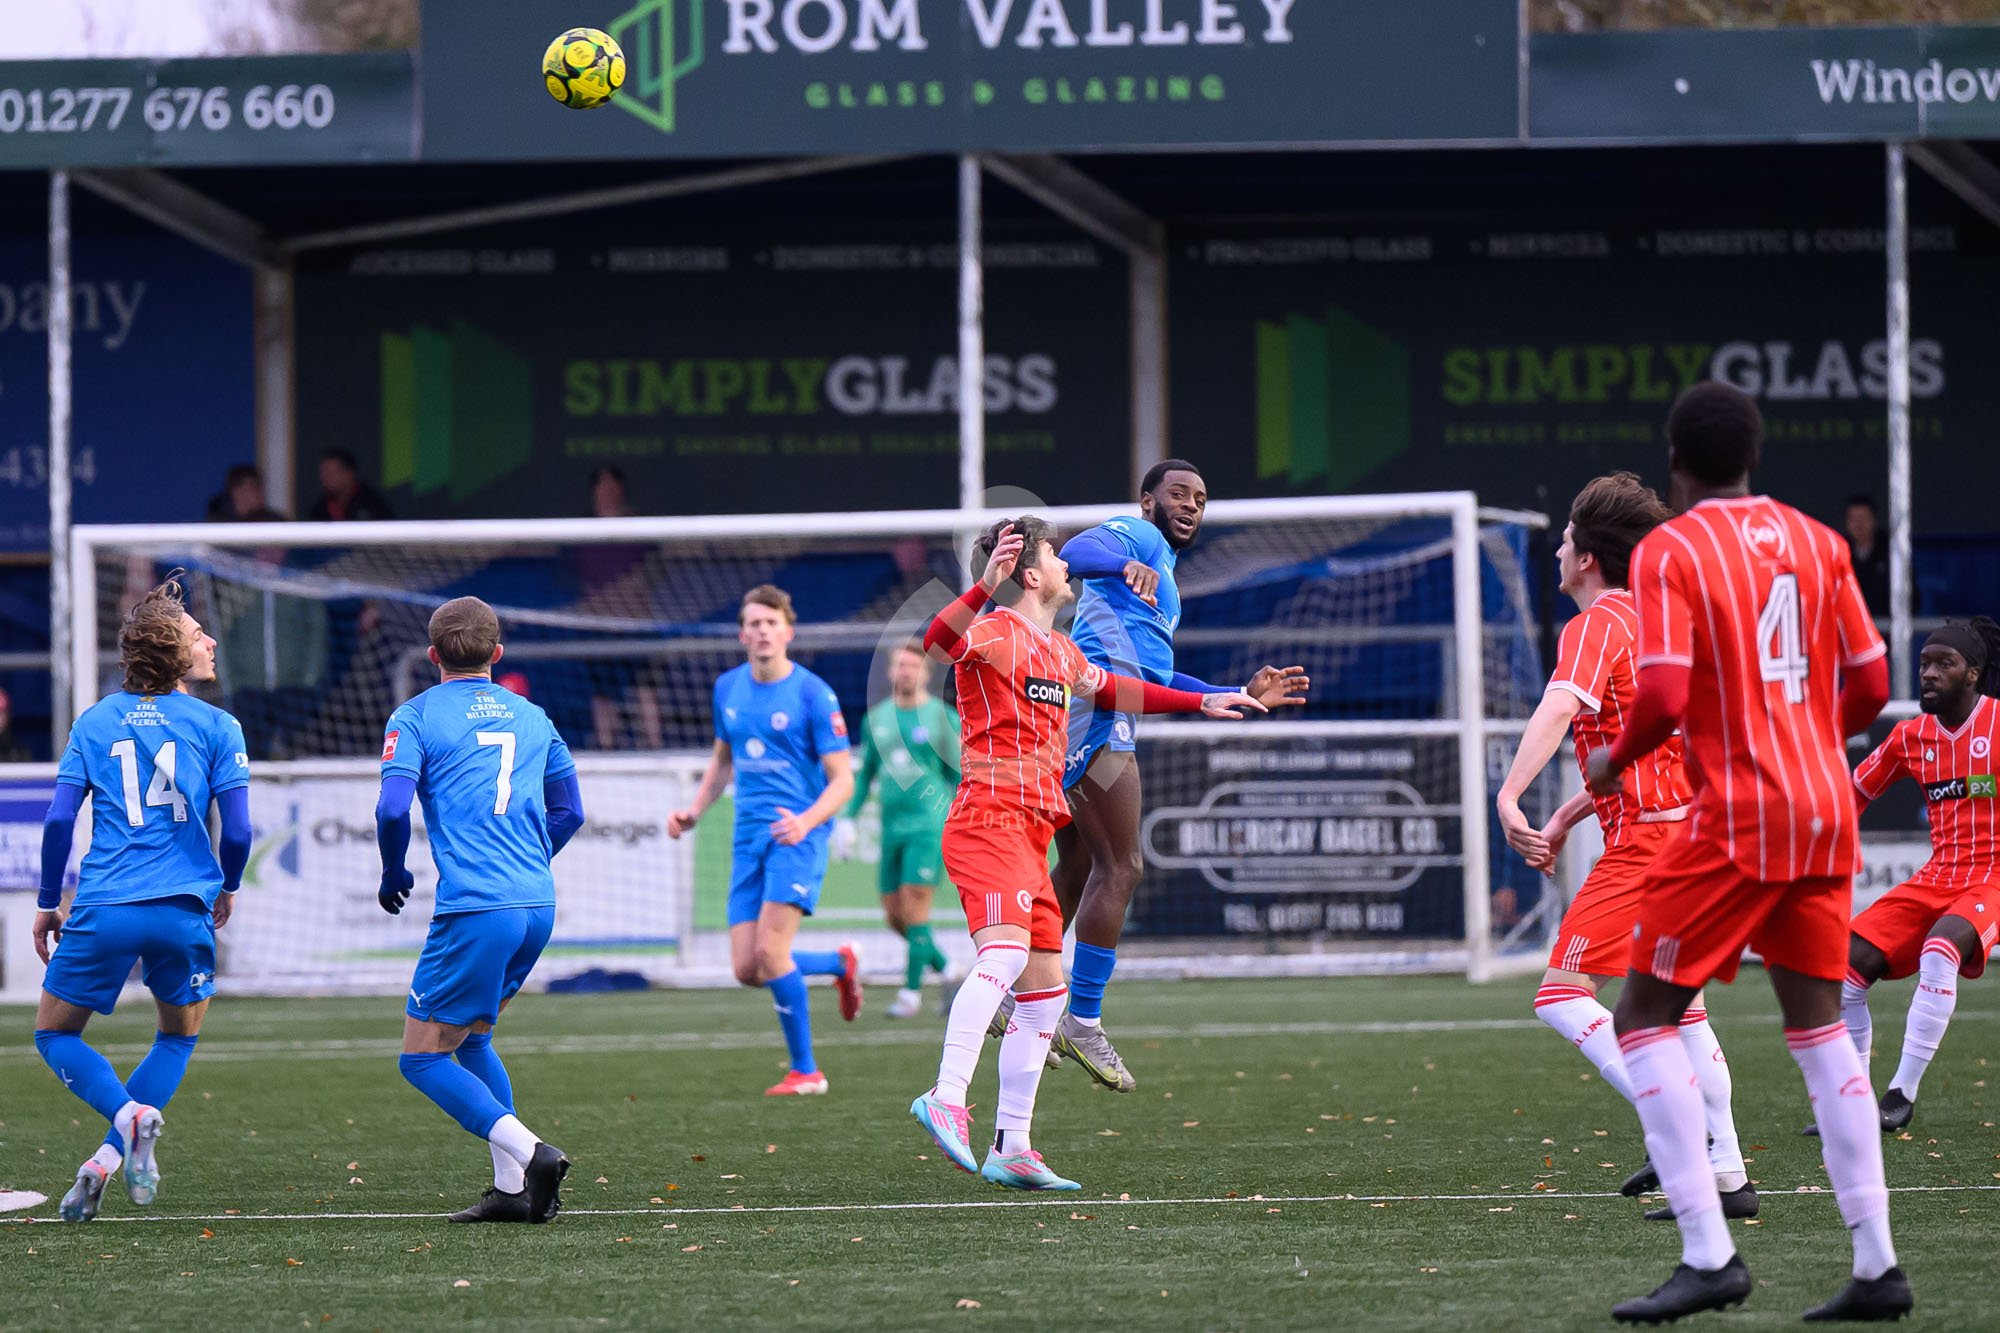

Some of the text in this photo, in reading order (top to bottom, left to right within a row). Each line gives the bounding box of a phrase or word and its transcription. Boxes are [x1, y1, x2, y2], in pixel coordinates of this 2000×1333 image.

[722, 0, 1295, 54] ROM VALLEY
[0, 83, 335, 133] 01277 676 660
[804, 81, 945, 109] GLASS
[1022, 75, 1225, 104] GLAZING
[1756, 572, 1809, 704] 4
[126, 711, 165, 719] CROWN
[135, 703, 158, 711] THE
[466, 710, 514, 719] BILLERICAY
[470, 703, 507, 711] CROWN
[476, 696, 496, 704] THE
[109, 737, 188, 827] 14
[475, 731, 517, 815] 7
